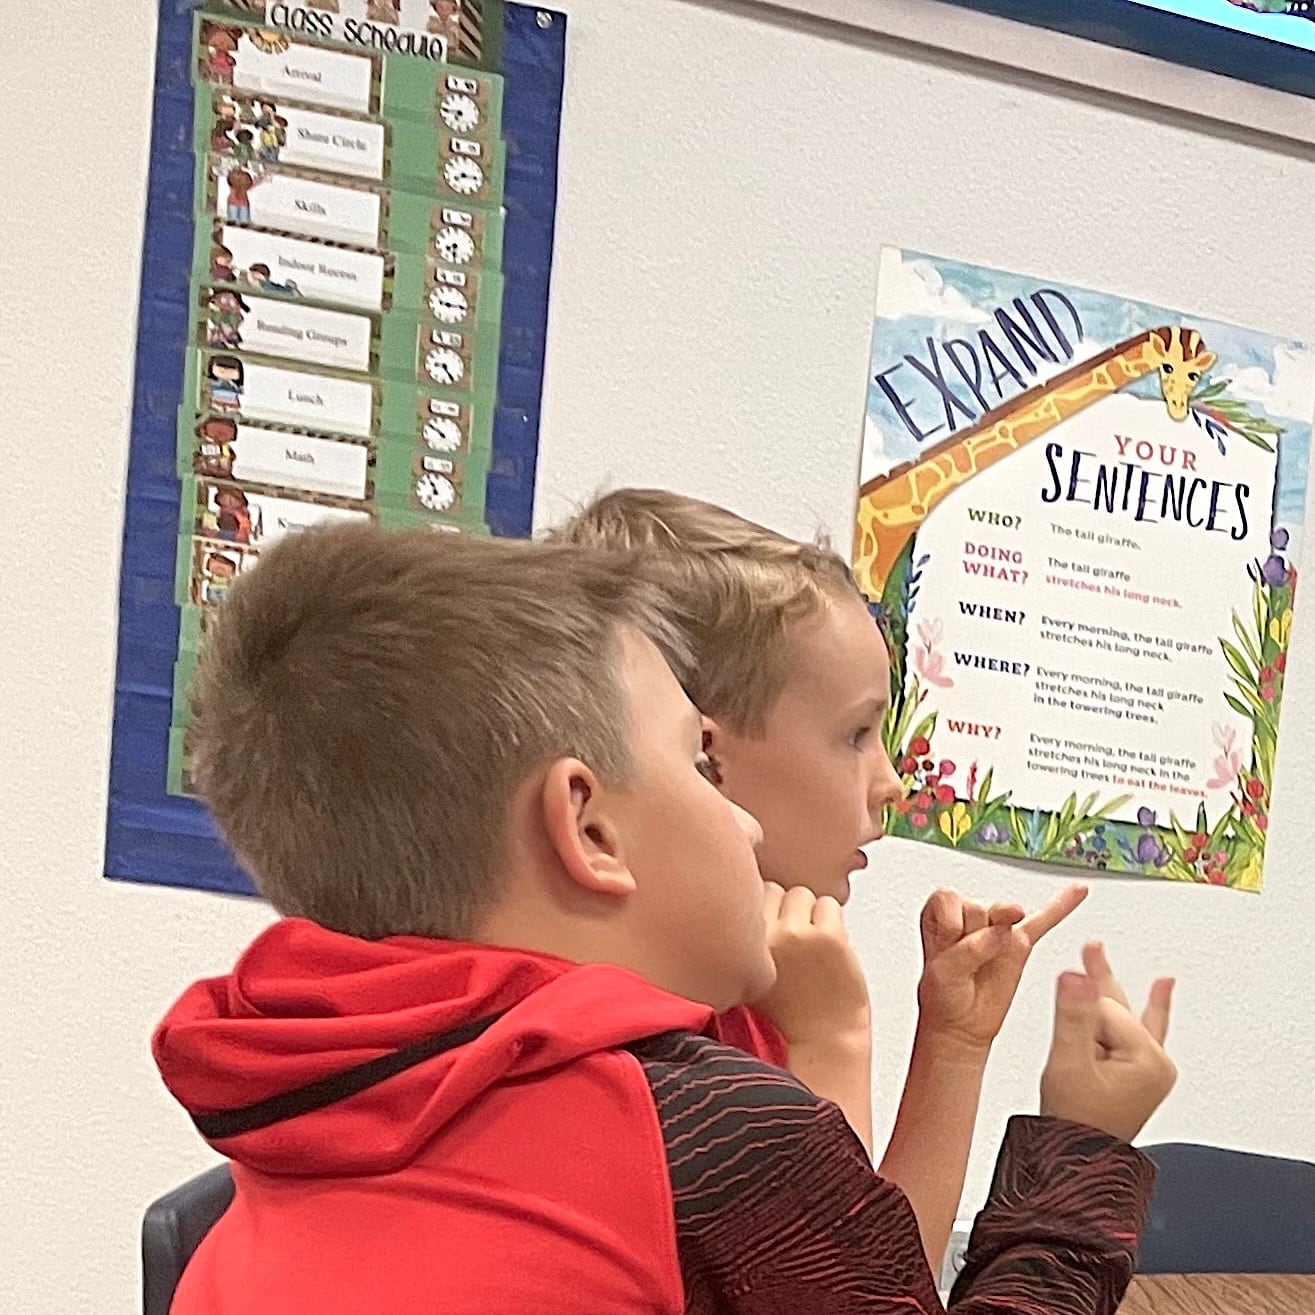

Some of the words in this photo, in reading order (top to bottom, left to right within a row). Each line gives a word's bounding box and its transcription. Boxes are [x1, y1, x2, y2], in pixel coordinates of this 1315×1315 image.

[874, 288, 1083, 442] EXPAND
[285, 449, 315, 465] Math
[1114, 435, 1198, 471] YOUR
[1041, 443, 1250, 541] SENTENCES
[968, 507, 1022, 530] WHO?
[964, 541, 1023, 564] DOING
[1050, 523, 1072, 536] The
[1075, 528, 1095, 541] tall
[1097, 534, 1142, 551] giraffe.
[962, 560, 1029, 585] WHAT?
[1048, 557, 1069, 570] The
[1071, 562, 1090, 575] tall
[1093, 567, 1131, 583] giraffe
[1045, 575, 1101, 594] stretches
[1104, 585, 1121, 597] his
[1124, 590, 1150, 604] long
[1152, 596, 1183, 609] neck.
[958, 601, 1026, 626] WHEN?
[1040, 631, 1093, 648] stretches
[1096, 639, 1112, 651] his
[1115, 643, 1140, 657] long
[1143, 649, 1173, 663] neck.
[1041, 615, 1074, 631] Every
[1077, 623, 1130, 642] morning,
[1134, 632, 1152, 645] the
[1155, 636, 1173, 648] tall
[1176, 641, 1213, 657] giraffe
[954, 652, 1030, 677] WHERE?
[1035, 680, 1088, 698] stretches
[1091, 690, 1107, 701] his
[1109, 693, 1135, 707] long
[1138, 699, 1164, 712] neck
[1036, 665, 1068, 682] Every
[1071, 674, 1122, 692] morning,
[1125, 681, 1143, 693] the
[1146, 685, 1164, 697] tall
[1167, 690, 1204, 705] giraffe
[1033, 692, 1045, 704] in
[1048, 695, 1067, 708] the
[1070, 700, 1122, 719] towering
[1125, 709, 1159, 724] trees.
[947, 718, 1002, 740] WHY?
[1028, 748, 1081, 764] stretches
[1084, 756, 1100, 768] his
[1103, 759, 1127, 773] long
[1131, 765, 1157, 777] neck
[1159, 768, 1170, 779] in
[1172, 770, 1190, 782] the
[1030, 732, 1062, 748] Every
[1065, 739, 1116, 758] morning,
[1118, 748, 1136, 760] the
[1140, 751, 1157, 763] tall
[1159, 755, 1196, 770] giraffe
[1027, 760, 1078, 778] towering
[1081, 769, 1110, 782] trees
[1113, 773, 1125, 785] to
[1127, 777, 1146, 789] eat
[1149, 779, 1167, 792] the
[1170, 784, 1208, 799] leaves.
